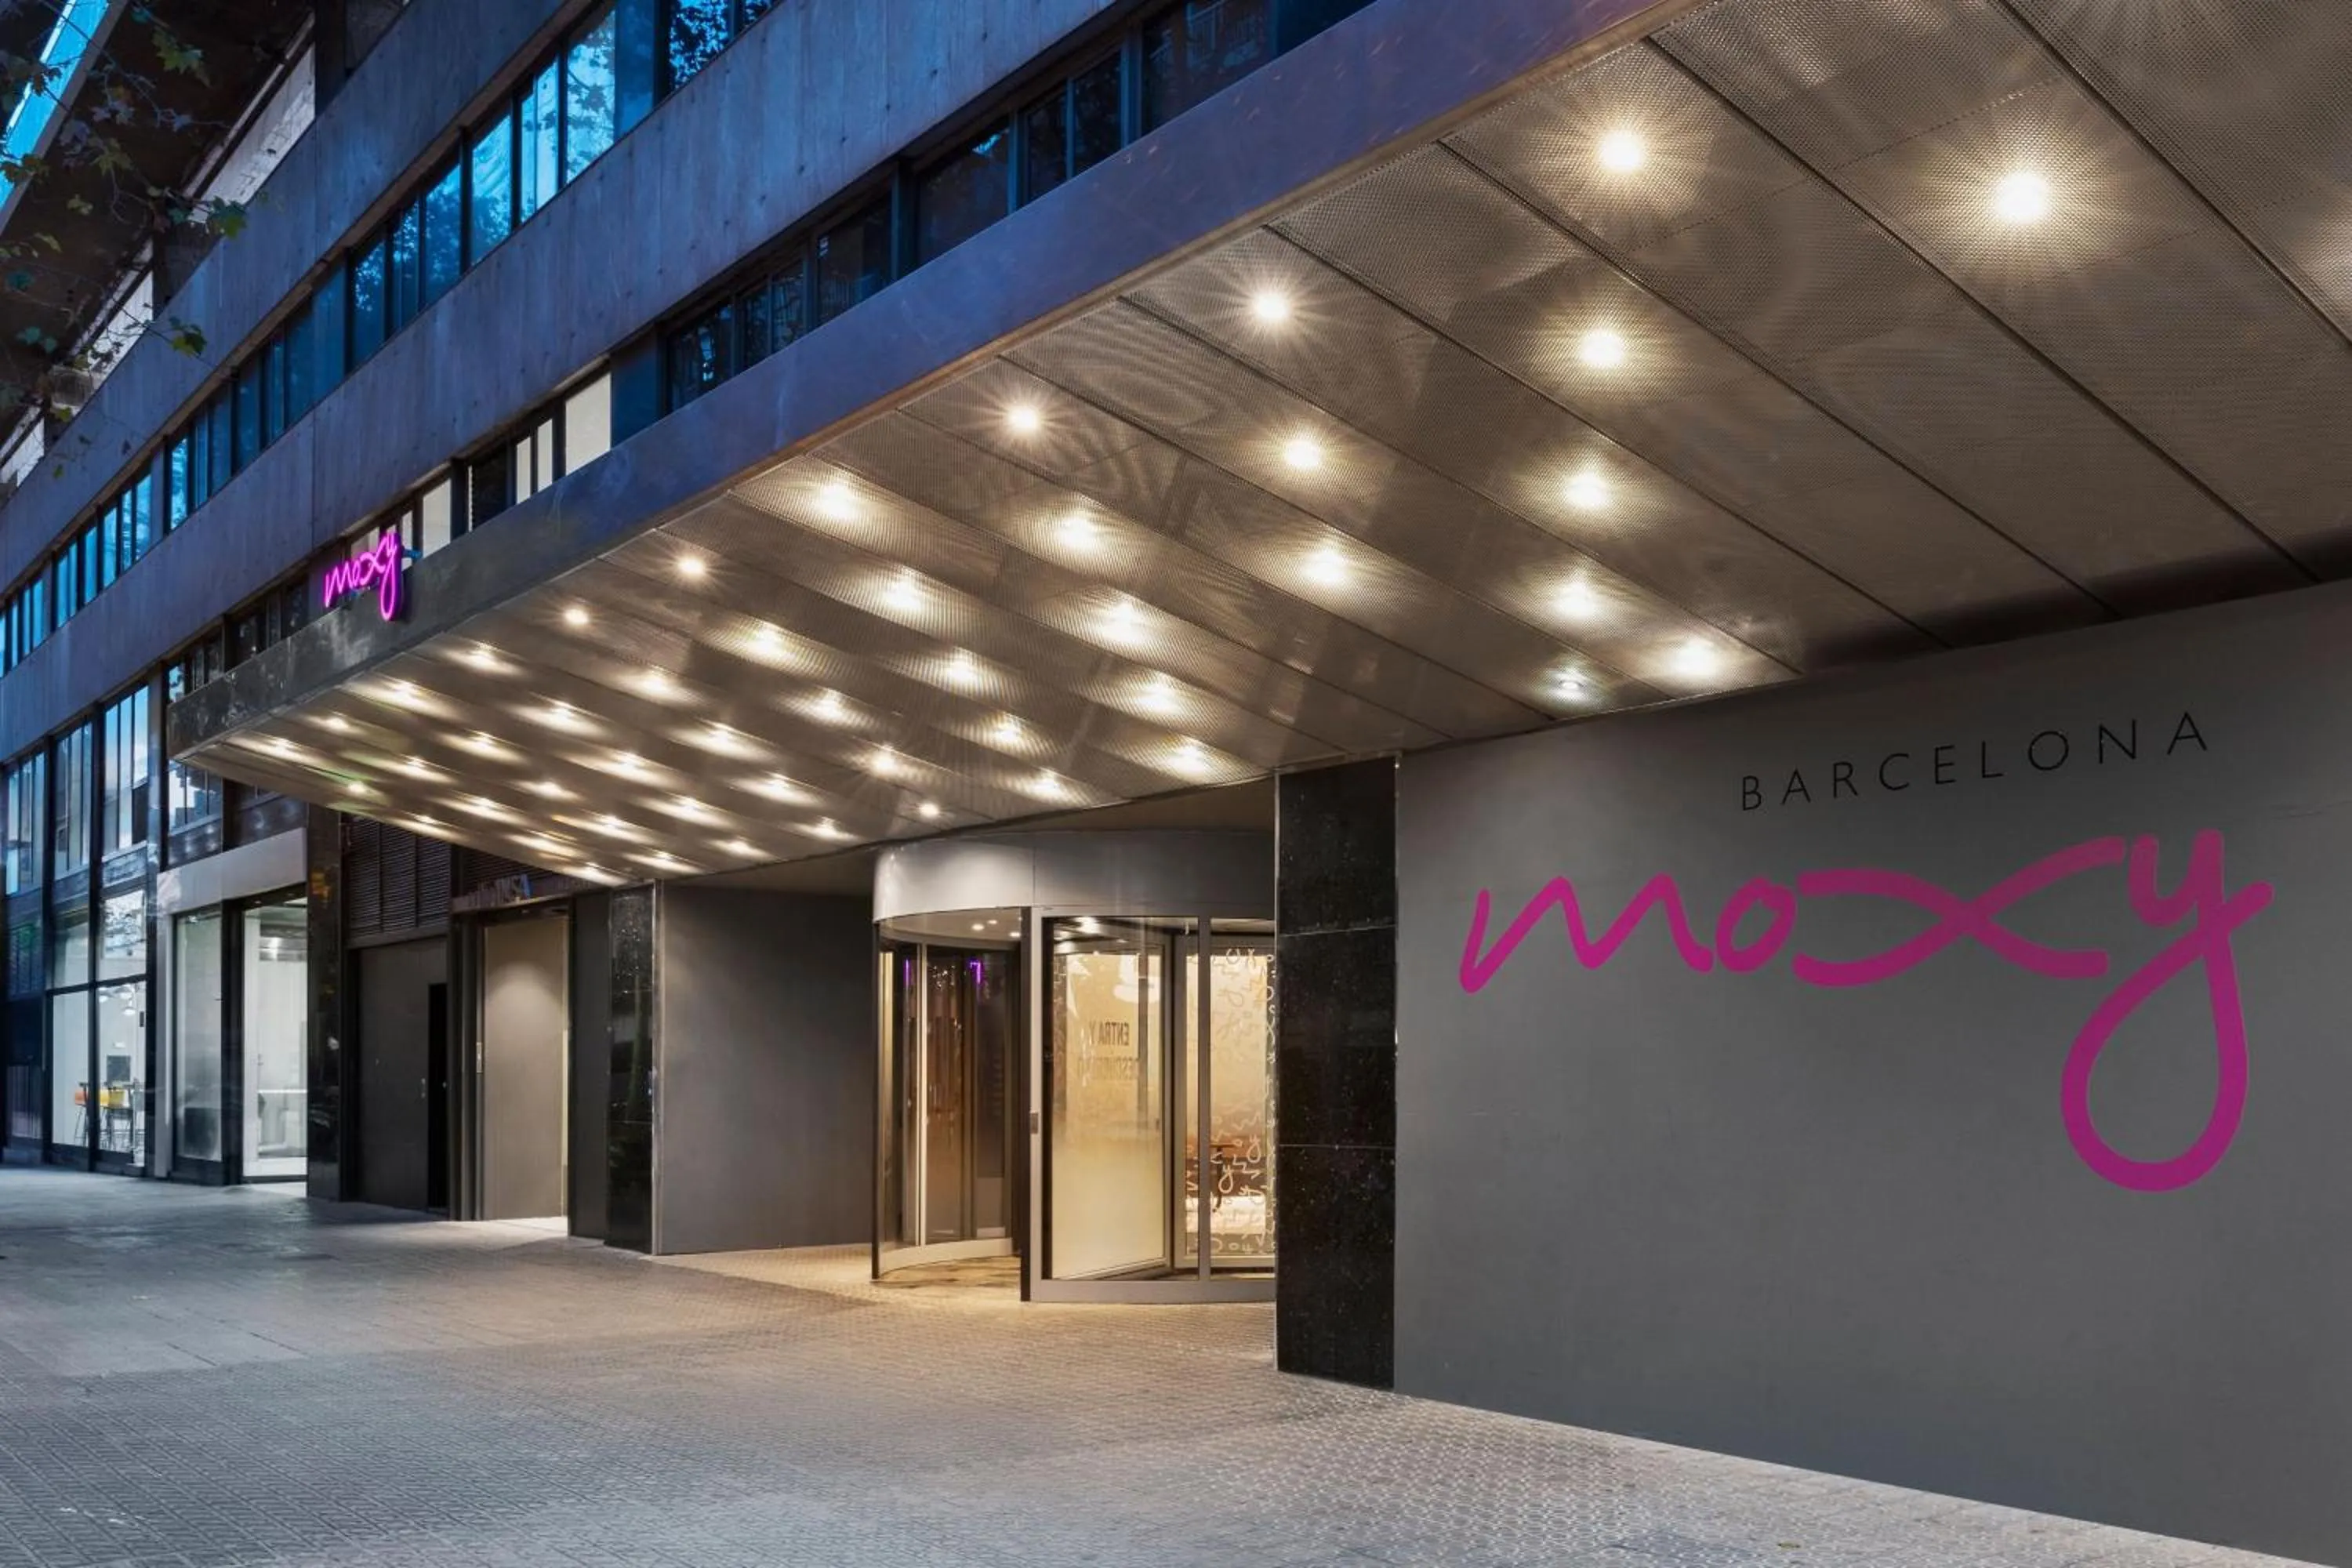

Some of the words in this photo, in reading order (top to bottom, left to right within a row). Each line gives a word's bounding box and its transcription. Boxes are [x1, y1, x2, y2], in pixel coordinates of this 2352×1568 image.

[322, 530, 399, 622] moxy
[1740, 710, 2209, 812] BARCELONA
[1458, 829, 2274, 1192] moxy
